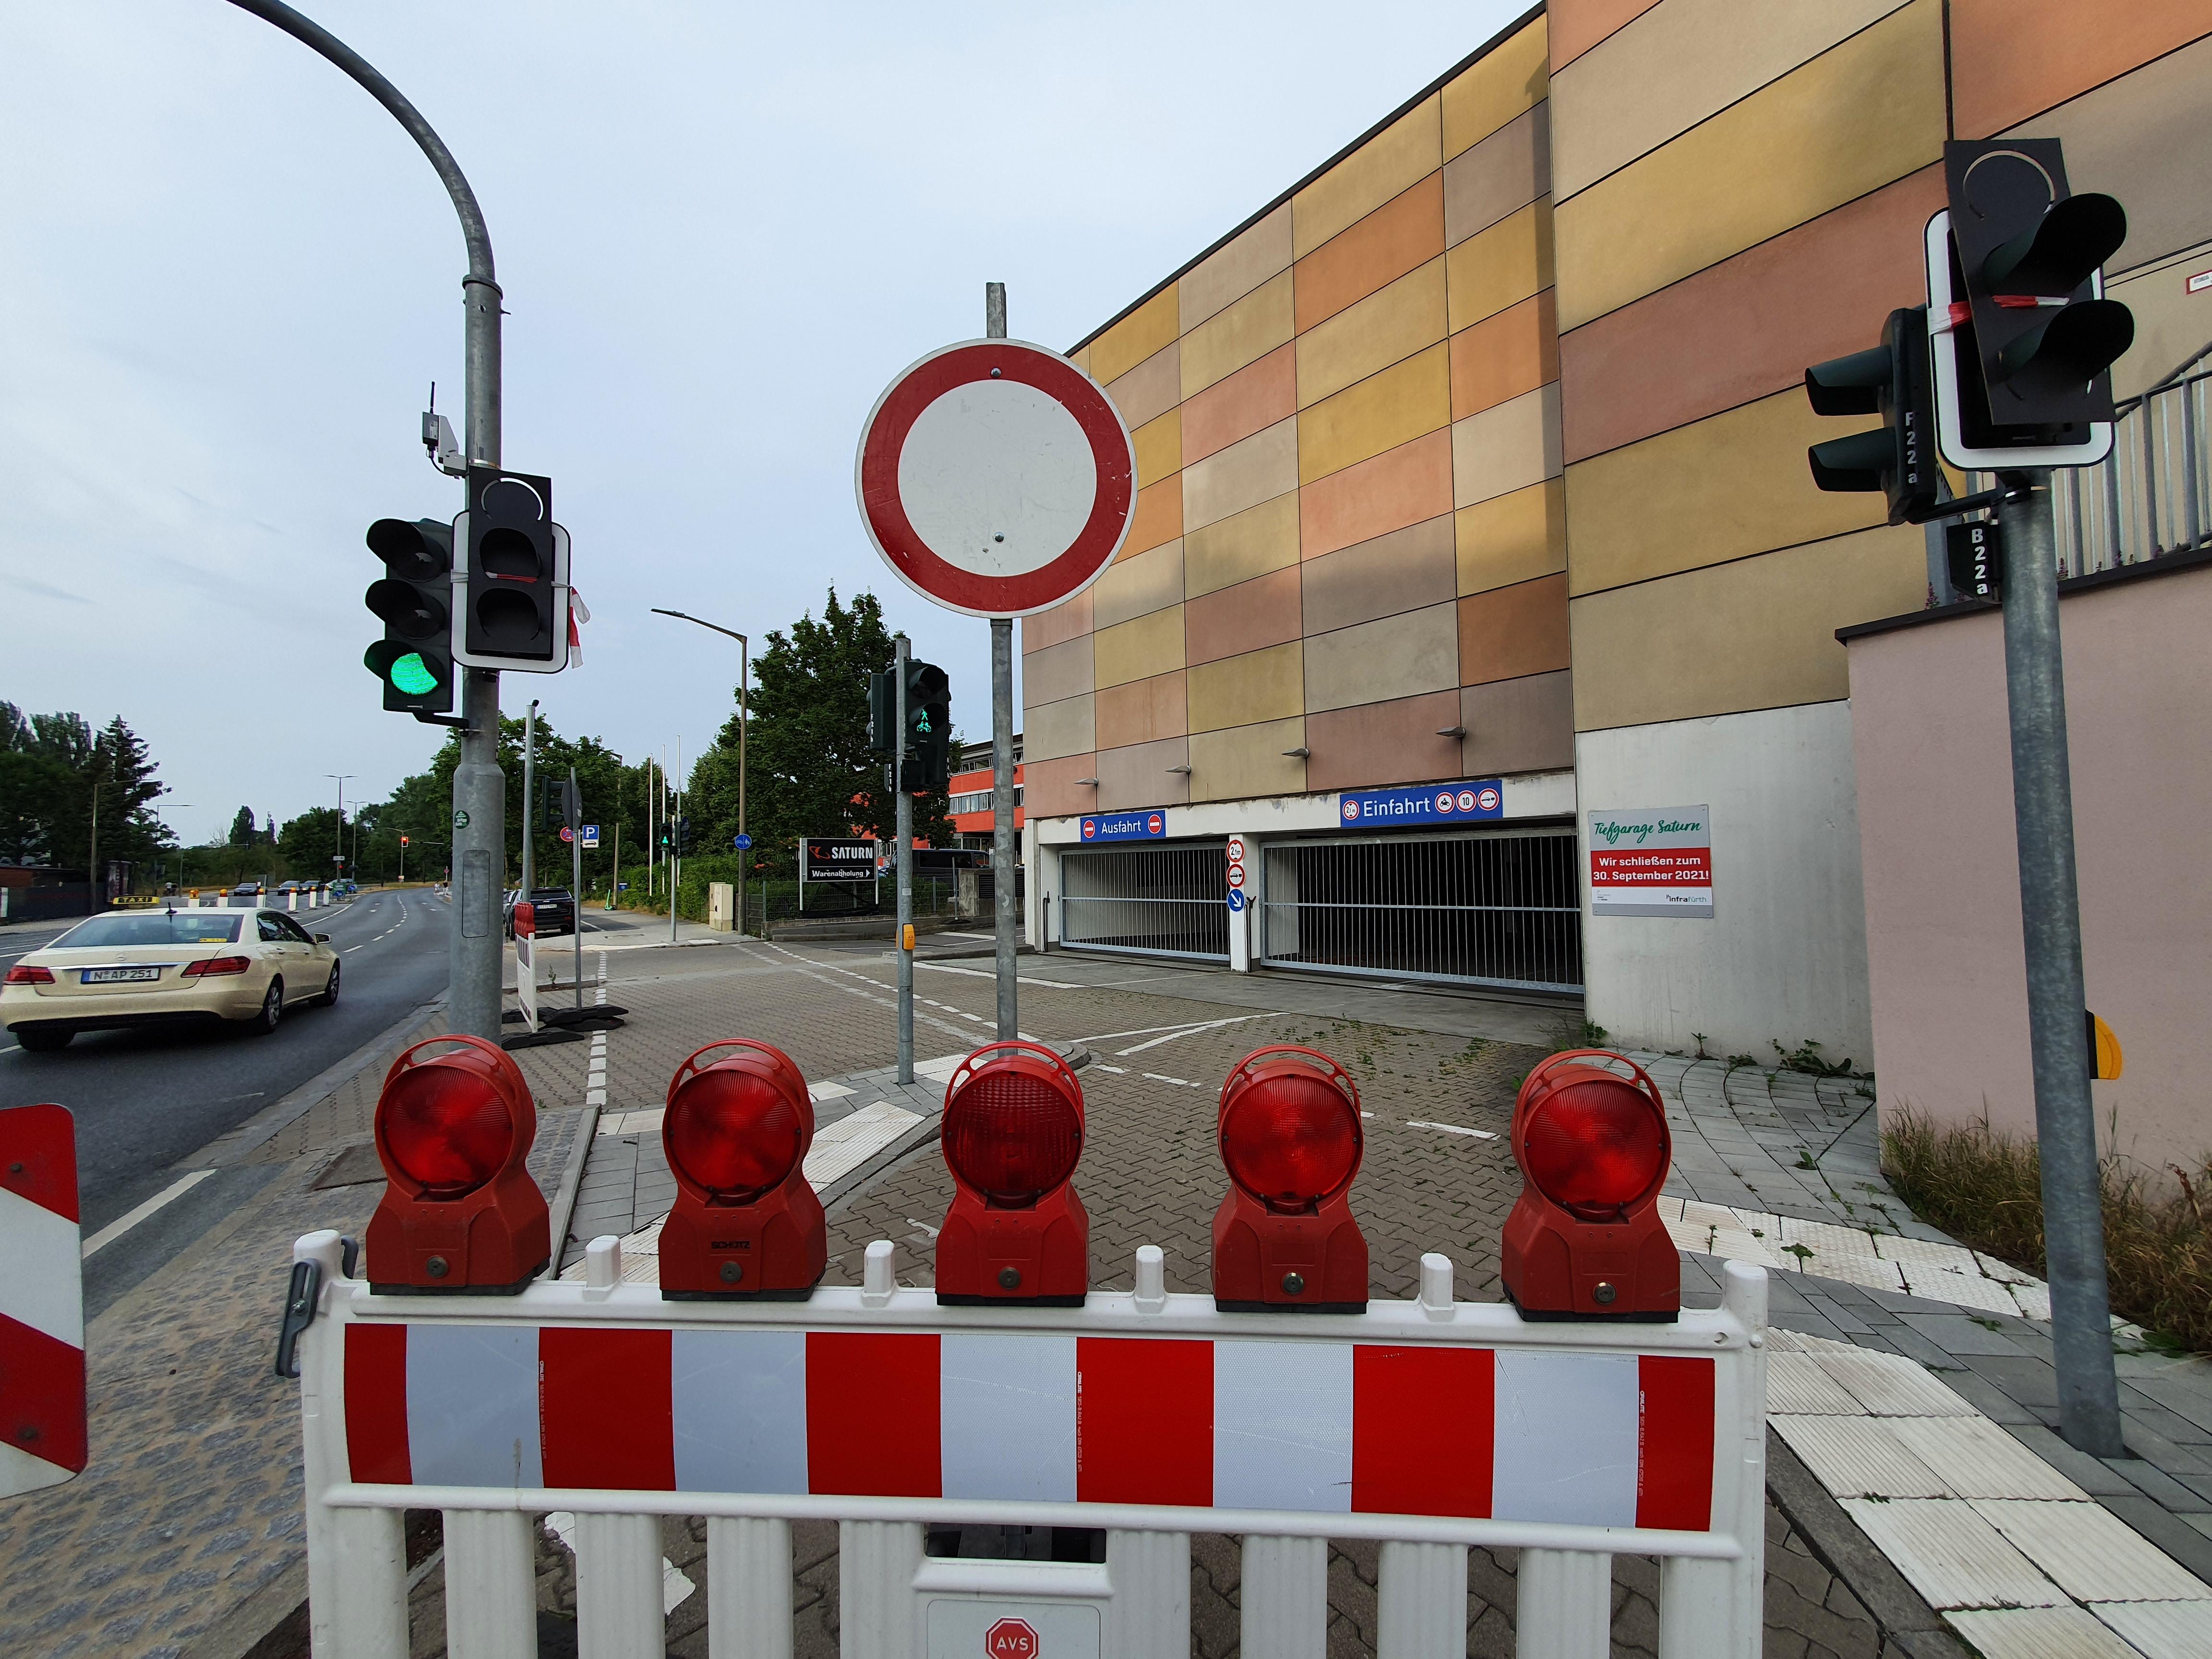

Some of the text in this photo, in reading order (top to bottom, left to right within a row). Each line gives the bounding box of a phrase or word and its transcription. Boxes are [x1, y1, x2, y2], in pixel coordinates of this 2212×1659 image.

[1363, 797, 1431, 817] Einfahrt
[1462, 797, 1469, 806] 10
[586, 827, 595, 838] P
[1101, 820, 1141, 834] Ausfahrt
[1594, 820, 1701, 844] Tiefgarage Saturn
[831, 847, 873, 859] SATURN
[1599, 856, 1701, 866] Wir schließen zum
[812, 869, 864, 878] Warenabholung
[1593, 870, 1709, 882] 30. September 2021!
[94, 969, 152, 980] N AP 251
[996, 1636, 1029, 1651] AVS
